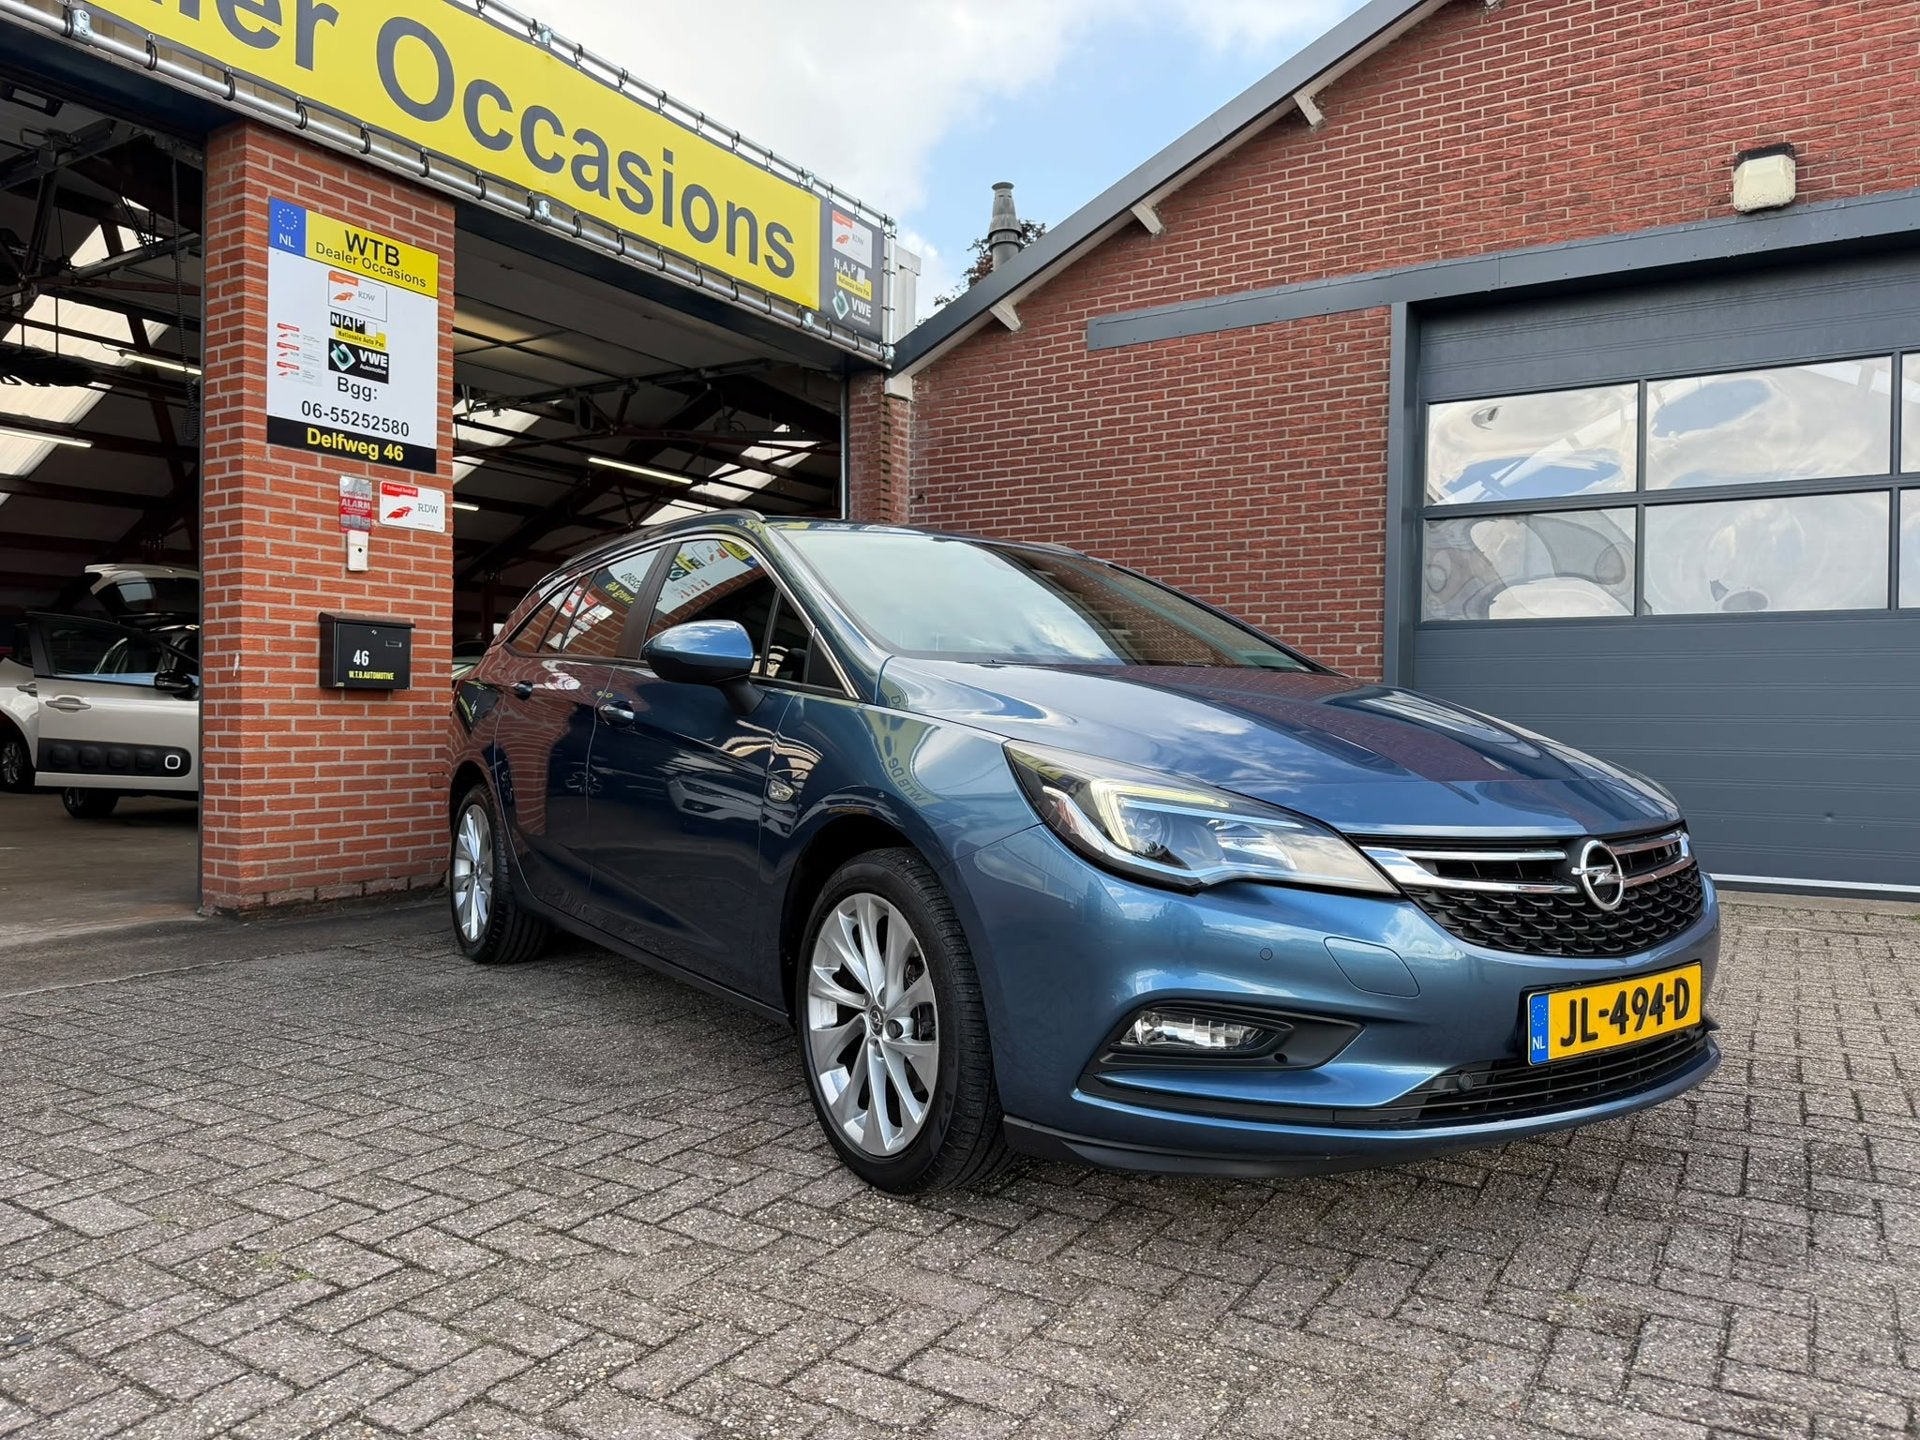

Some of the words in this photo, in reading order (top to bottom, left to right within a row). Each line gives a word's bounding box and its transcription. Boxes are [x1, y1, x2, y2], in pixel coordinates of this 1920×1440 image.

[179, 0, 340, 72] er
[376, 16, 796, 279] Occasions
[279, 233, 295, 248] NL
[344, 229, 400, 267] WTB
[315, 241, 358, 265] Dealer
[362, 257, 427, 288] Occasions
[851, 296, 872, 318] VWE
[359, 349, 388, 368] VWE
[337, 376, 378, 402] Bgg:
[302, 400, 410, 437] 06-55252580
[307, 427, 379, 460] Delfweg
[383, 446, 404, 461] 46
[341, 498, 371, 511] ALARM
[417, 503, 438, 514] RDW
[353, 649, 370, 666] 46
[1560, 977, 1690, 1047] JL-494-D
[1532, 1035, 1546, 1050] NL
